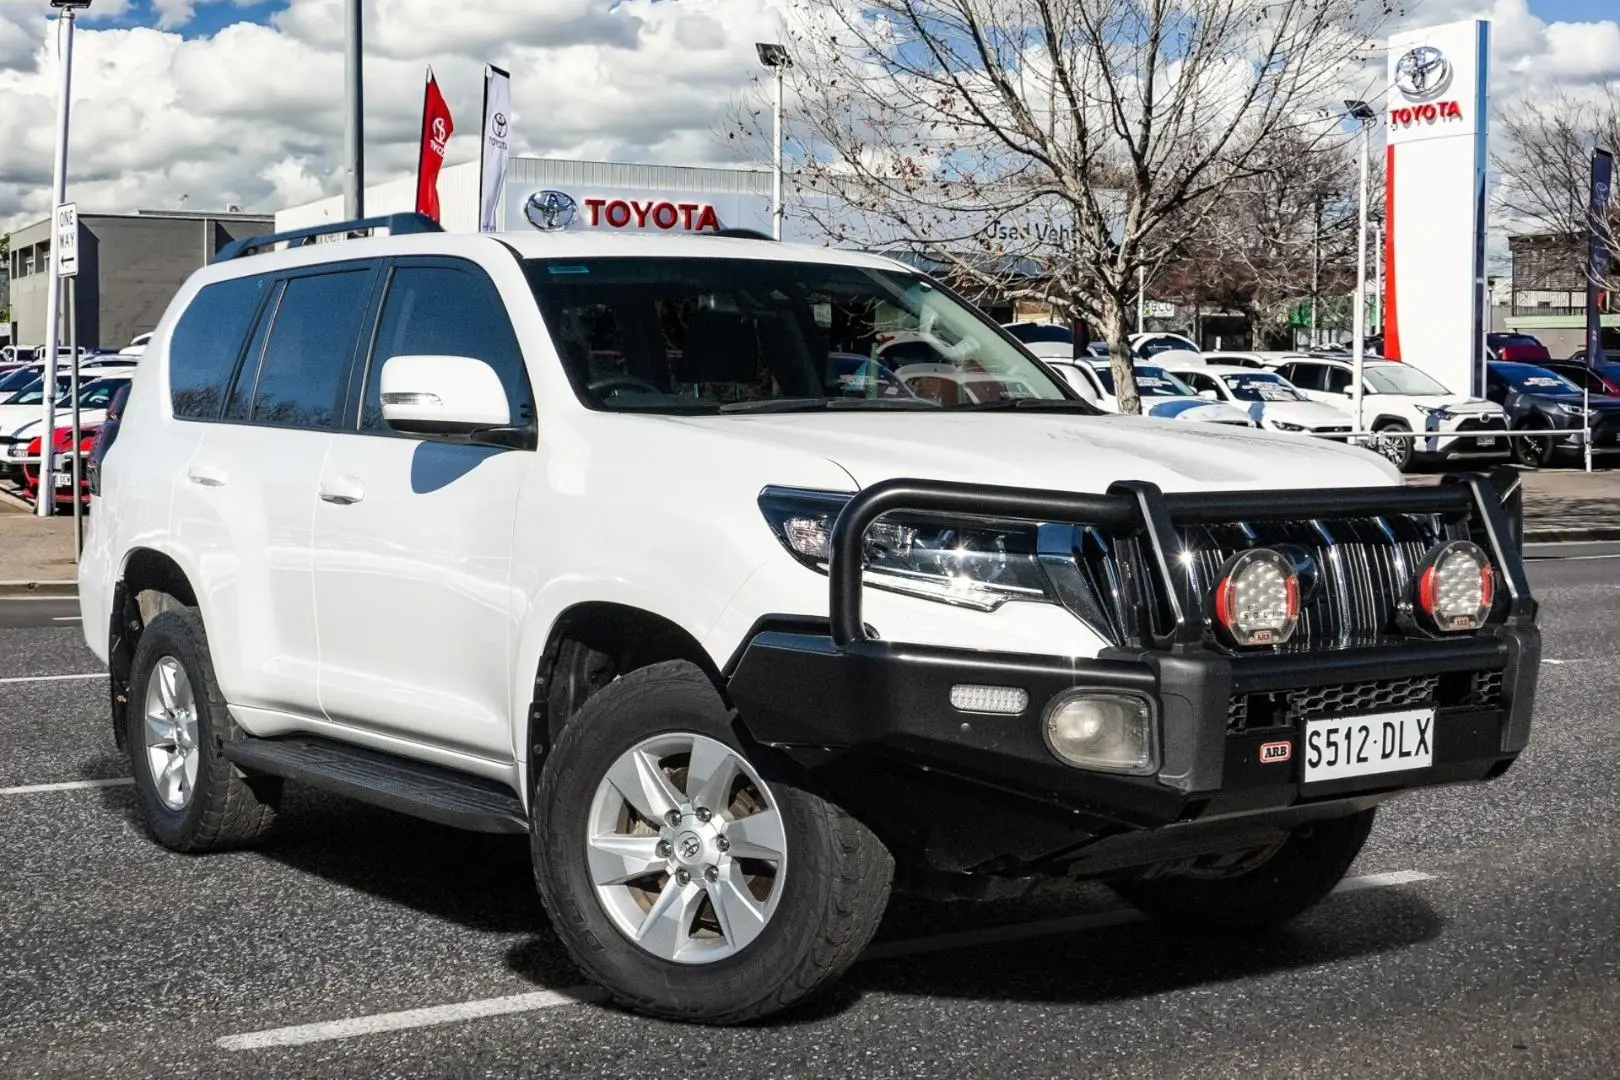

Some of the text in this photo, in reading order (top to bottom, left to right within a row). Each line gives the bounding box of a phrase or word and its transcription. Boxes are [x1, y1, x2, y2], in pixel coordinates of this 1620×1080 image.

[1390, 101, 1462, 124] TOYOTA
[60, 209, 73, 228] ONE
[585, 199, 720, 231] TOYOTA
[985, 220, 1030, 240] Used
[60, 231, 75, 249] WAY
[1264, 746, 1287, 758] ARB
